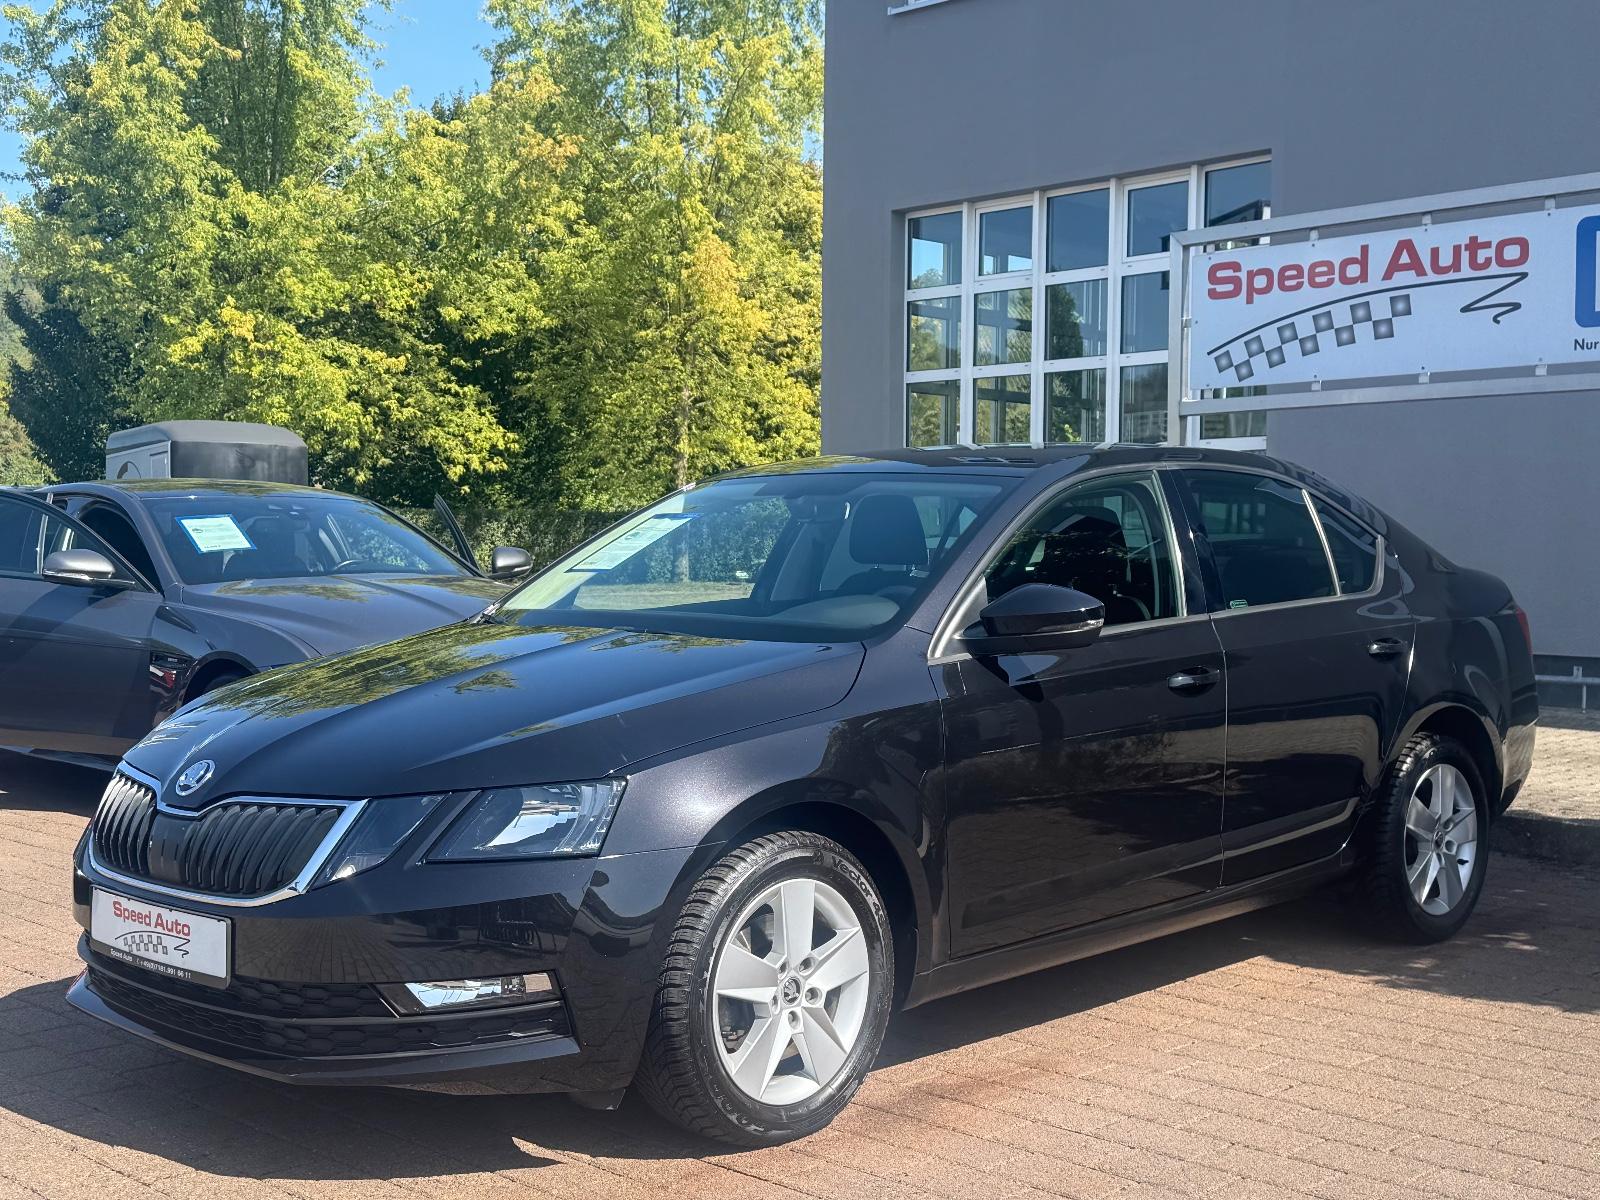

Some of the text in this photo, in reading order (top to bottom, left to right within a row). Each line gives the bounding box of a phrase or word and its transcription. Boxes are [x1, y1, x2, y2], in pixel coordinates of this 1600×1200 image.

[1207, 235, 1530, 304] Speed Auto
[1573, 338, 1600, 351] Nur
[831, 855, 873, 898] Vector
[113, 901, 190, 936] Speed Auto
